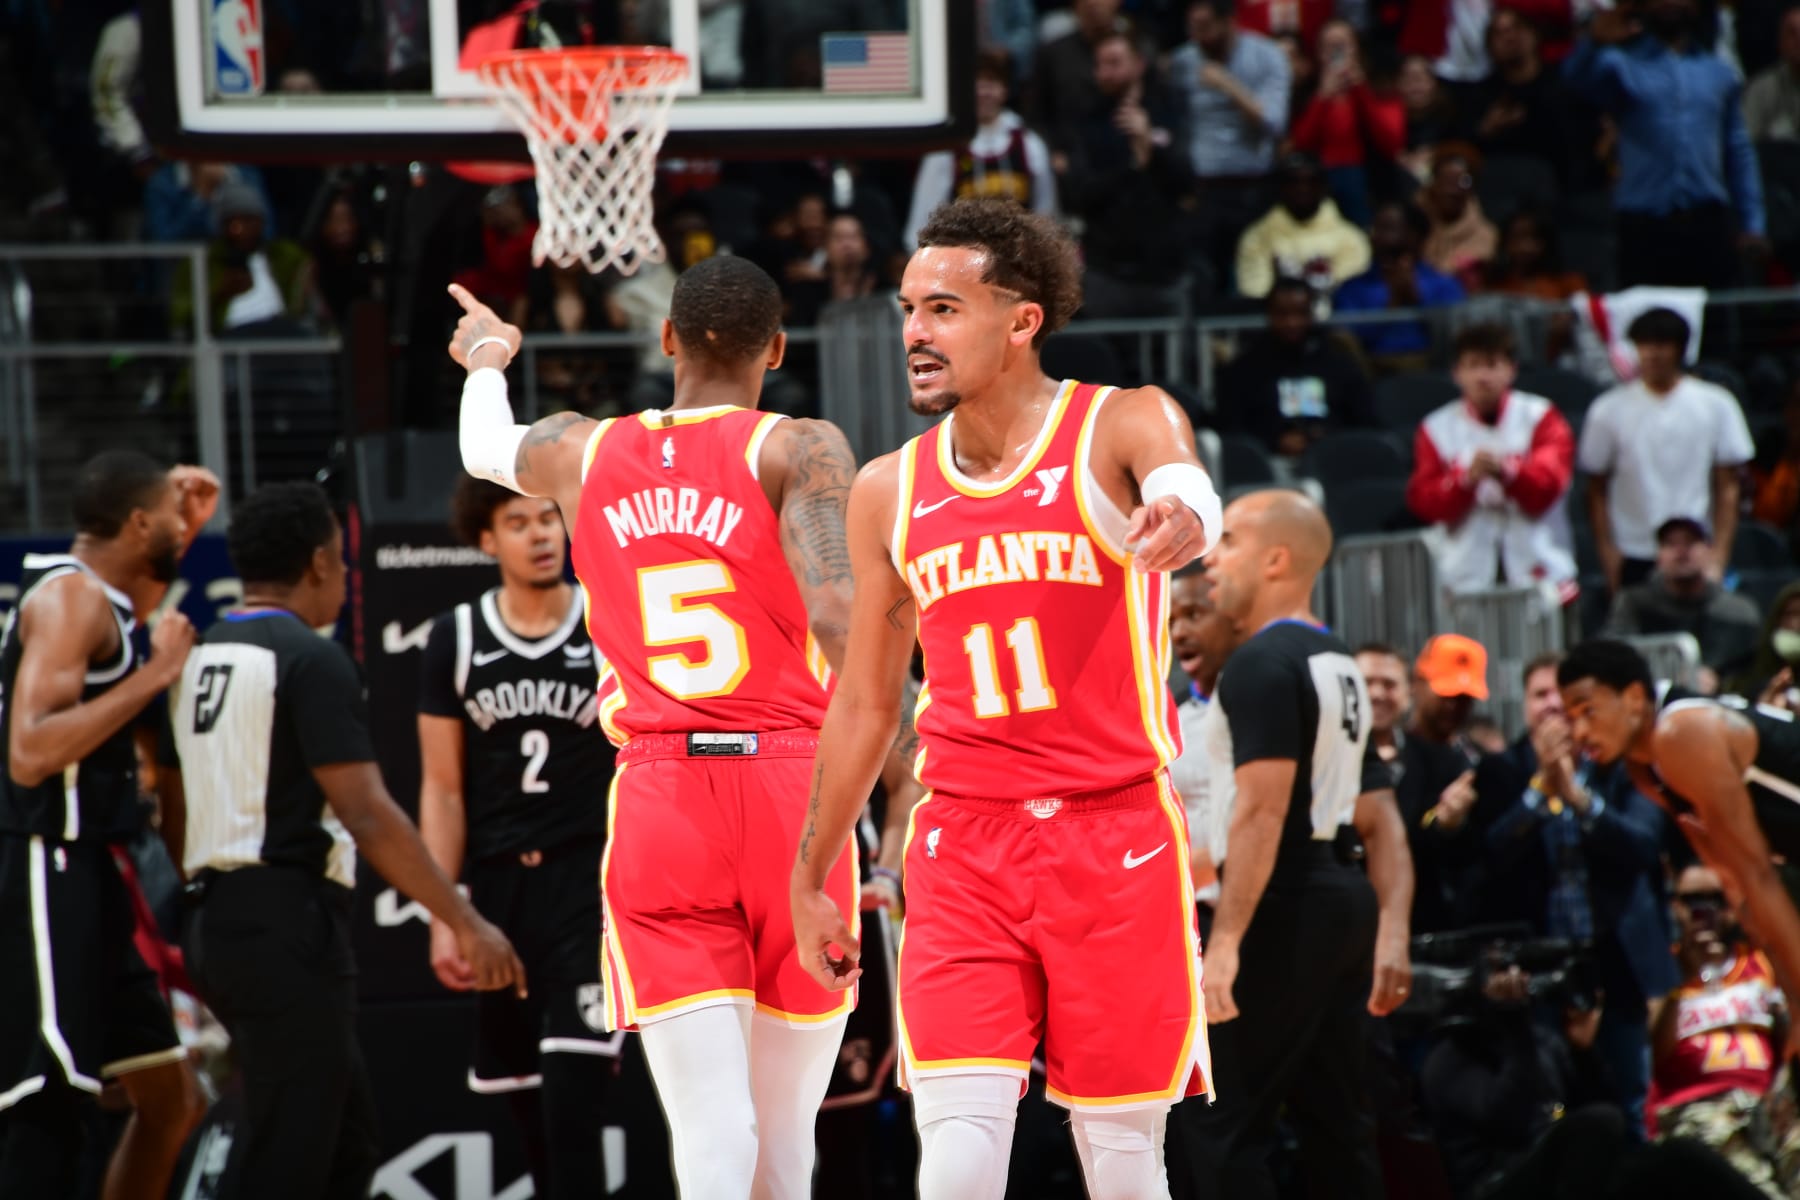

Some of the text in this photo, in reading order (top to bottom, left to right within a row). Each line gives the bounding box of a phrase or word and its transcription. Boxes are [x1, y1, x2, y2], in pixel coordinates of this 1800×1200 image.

[603, 487, 743, 549] MURRAY
[1023, 488, 1039, 498] the
[905, 530, 1104, 612] ATLANTA
[637, 559, 750, 699] 5
[192, 664, 234, 735] 27
[962, 616, 1058, 719] 11
[520, 728, 550, 794] 2
[1023, 797, 1064, 811] HAWKS
[1702, 1031, 1770, 1074] 21
